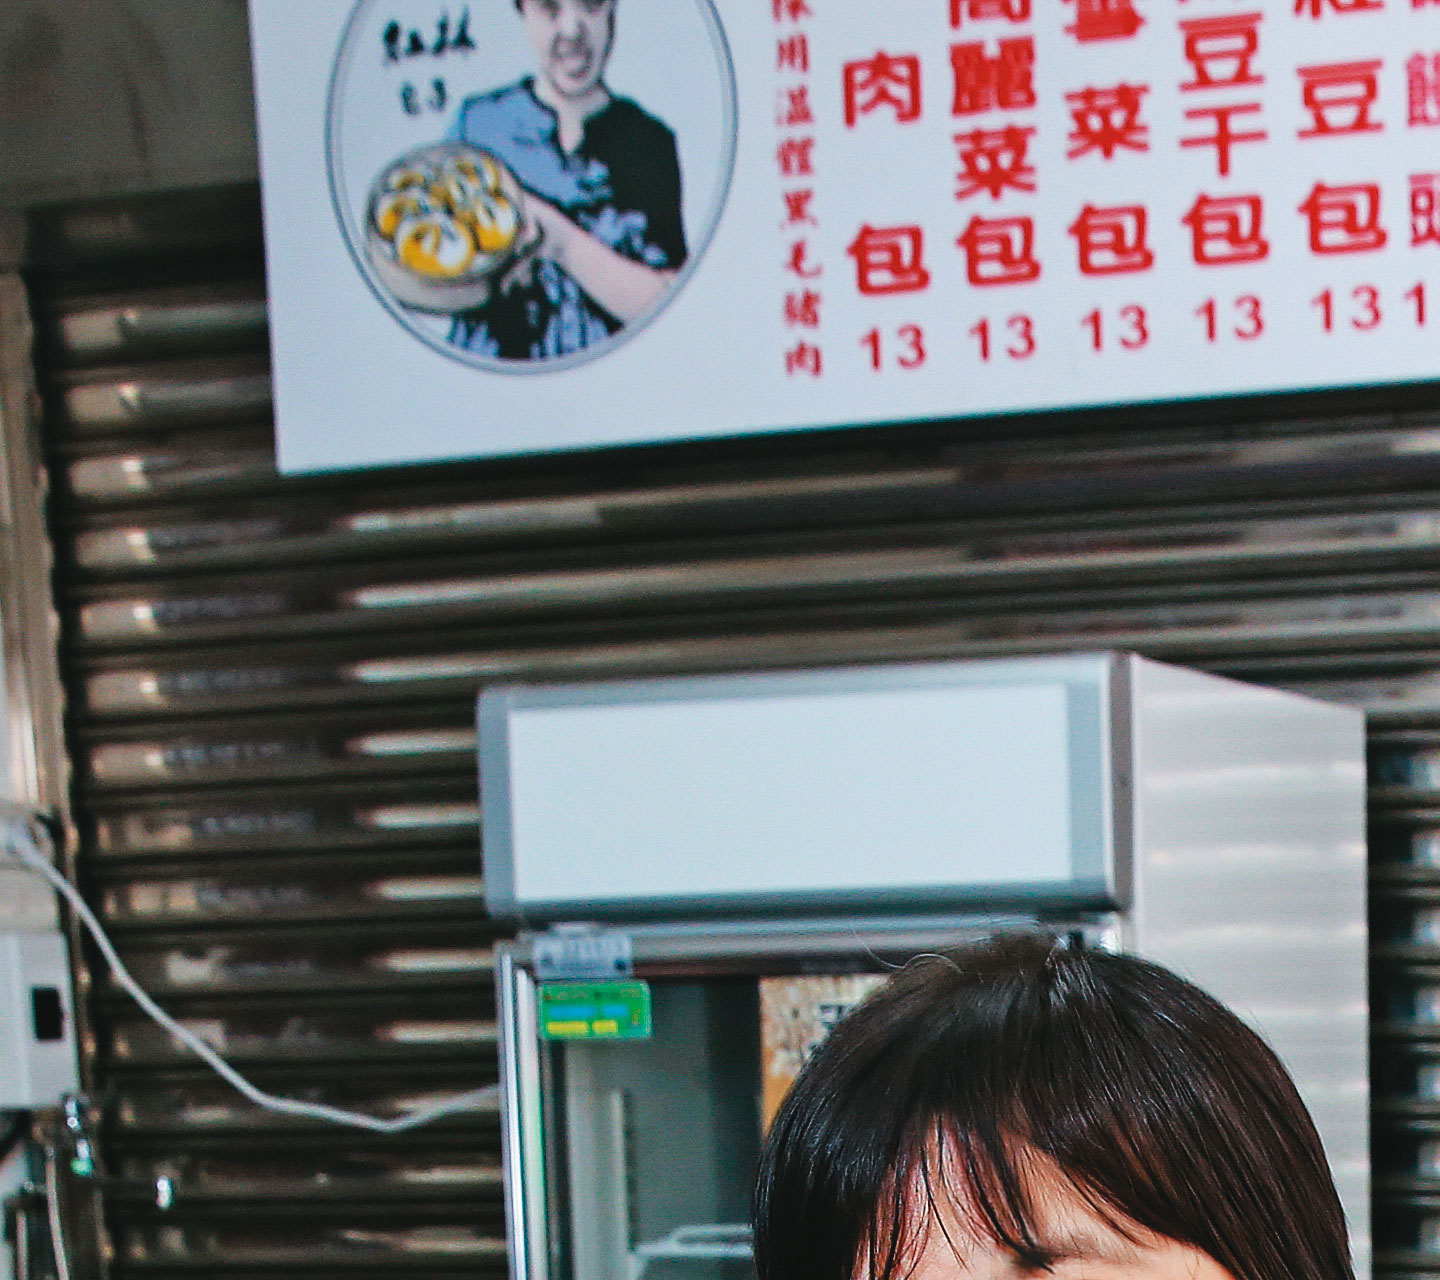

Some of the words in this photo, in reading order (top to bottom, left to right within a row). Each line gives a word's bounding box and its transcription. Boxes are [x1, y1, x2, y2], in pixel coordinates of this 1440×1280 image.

[1293, 0, 1389, 257] 豆包
[841, 50, 933, 298] 肉包
[1082, 305, 1151, 352] 13
[1196, 295, 1265, 343] 13
[1312, 285, 1383, 333] 13
[861, 324, 927, 372] 13
[970, 314, 1037, 361] 13
